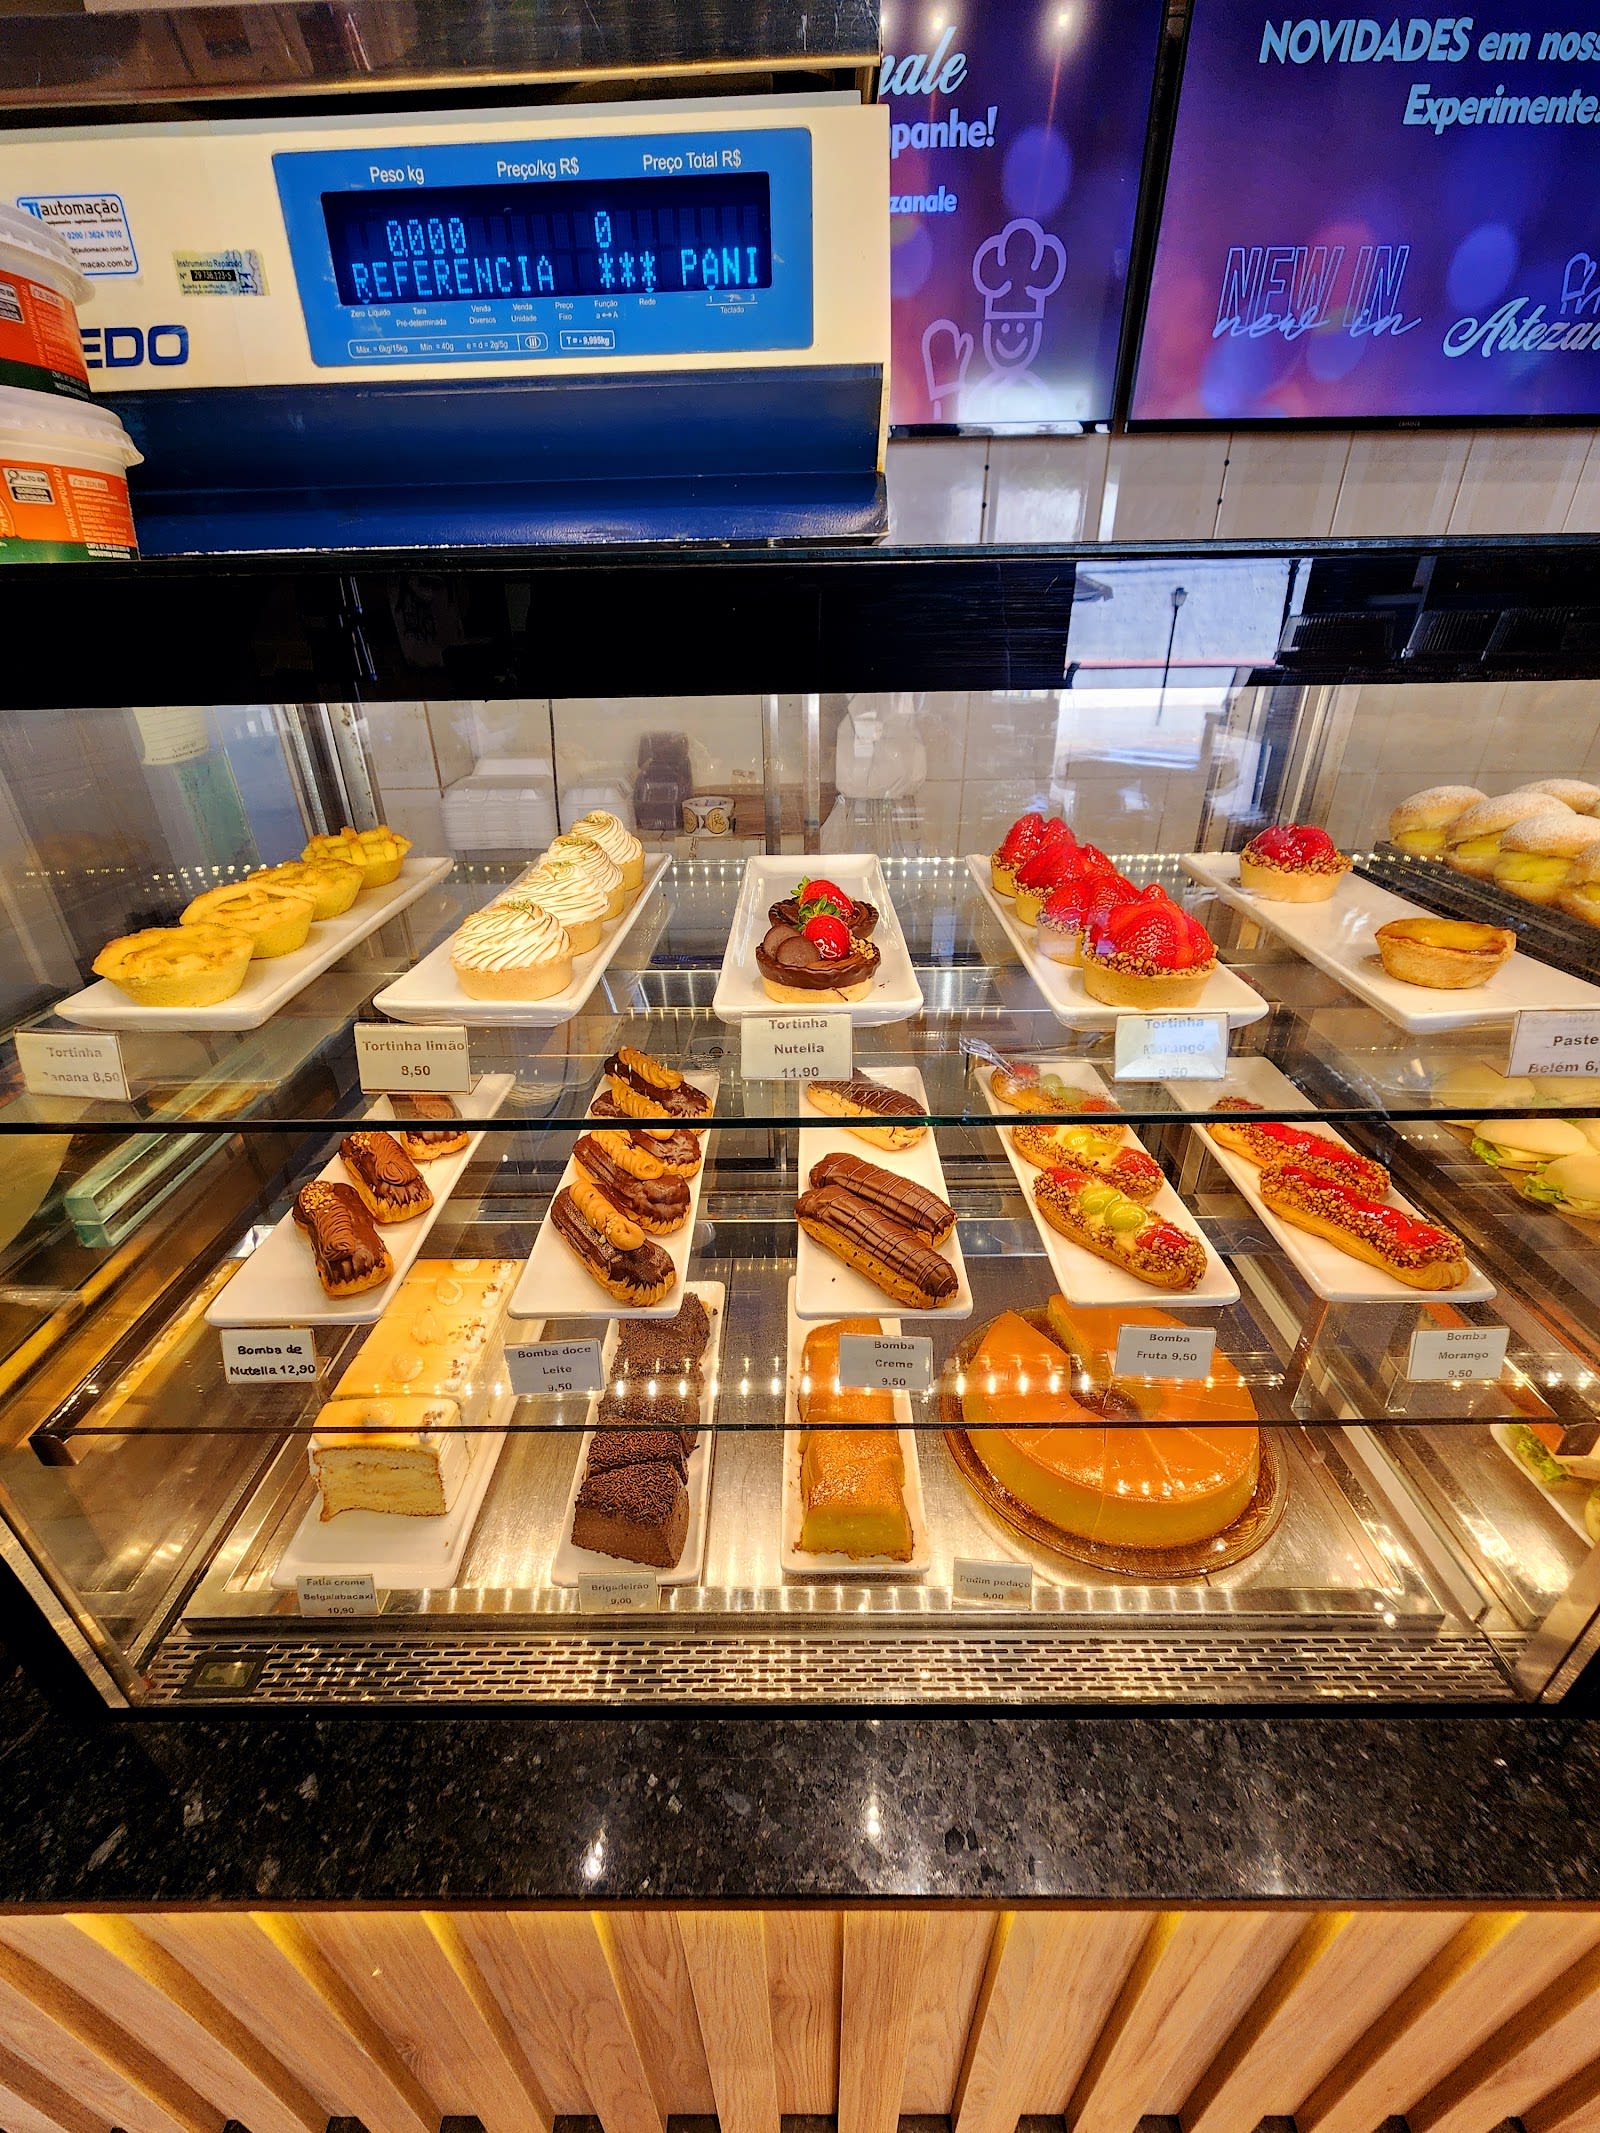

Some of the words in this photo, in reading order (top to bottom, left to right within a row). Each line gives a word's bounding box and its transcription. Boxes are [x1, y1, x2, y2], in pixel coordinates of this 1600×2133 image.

[1259, 17, 1474, 64] NOVIDADES
[1478, 31, 1531, 61] em
[1537, 31, 1600, 62] noss
[890, 106, 998, 160] panhe!
[643, 154, 683, 174] Preço
[686, 151, 718, 169] Total
[722, 148, 742, 169] R$
[496, 159, 557, 181] Preço/kg
[560, 156, 580, 177] R$
[369, 165, 404, 184] Peso
[407, 165, 425, 185] kg
[890, 185, 958, 213] zanale
[41, 199, 119, 218] automação
[594, 211, 612, 248] 0
[352, 255, 554, 298] REFERENCIA
[681, 247, 758, 286] PANI
[1217, 246, 1345, 327] NEW
[1342, 245, 1410, 327] IN
[554, 301, 574, 310] Preço
[594, 299, 618, 309] Função
[638, 297, 656, 306] Rede
[413, 307, 427, 315] Tara
[471, 304, 492, 313] Venda
[512, 303, 533, 312] Venda
[720, 305, 745, 315] Teclado
[469, 315, 497, 325] Diversos
[511, 314, 538, 323] Unidade
[558, 312, 573, 321] Fixo
[612, 311, 619, 319] A
[80, 325, 189, 368] EDO
[441, 341, 454, 352] 40g
[768, 1018, 828, 1030] Tortinha
[1144, 1017, 1204, 1029] Tortinha
[362, 1040, 422, 1051] Tortinha
[426, 1040, 465, 1051] limão
[1553, 1034, 1599, 1047] Paste
[46, 1047, 103, 1058] Tortinha
[774, 1043, 825, 1054] Nutella
[401, 1065, 431, 1077] 8,50
[1528, 1062, 1579, 1073] Belém
[43, 1072, 89, 1082] anana
[1150, 1334, 1191, 1342] Bomba
[1447, 1332, 1487, 1341] Bomba
[238, 1345, 282, 1355] Bomba
[286, 1344, 303, 1354] de
[874, 1341, 915, 1350] Bomba
[518, 1349, 558, 1358] Bomba
[562, 1346, 591, 1355] doce
[1137, 1351, 1168, 1360] Fruta
[1438, 1351, 1489, 1361] Morango
[542, 1365, 573, 1374] Leite
[875, 1359, 914, 1369] Creme
[230, 1366, 277, 1375] Nutella
[280, 1364, 316, 1376] 12,90
